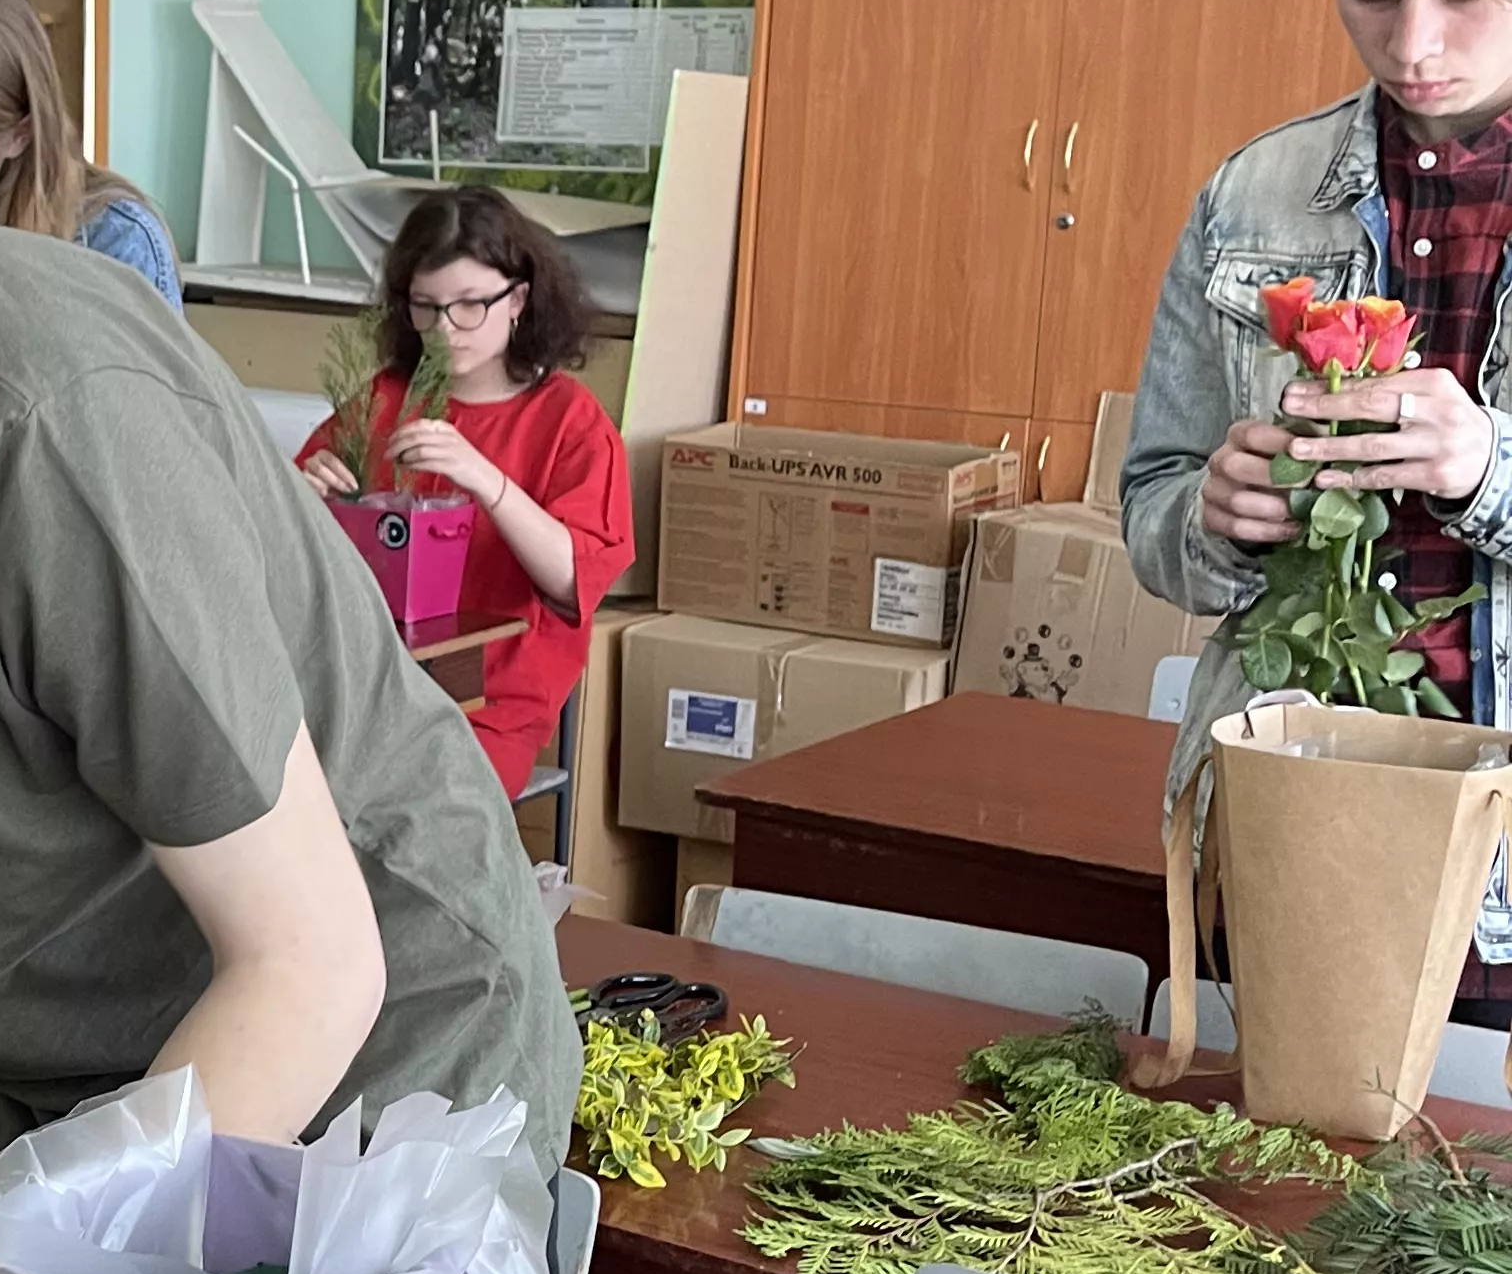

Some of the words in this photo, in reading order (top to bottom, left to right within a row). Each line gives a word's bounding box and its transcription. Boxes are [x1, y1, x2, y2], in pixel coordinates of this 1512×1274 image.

[672, 448, 714, 467] APC
[729, 453, 807, 477] Back-UPS
[809, 462, 848, 481] AVR
[852, 467, 883, 485] 500
